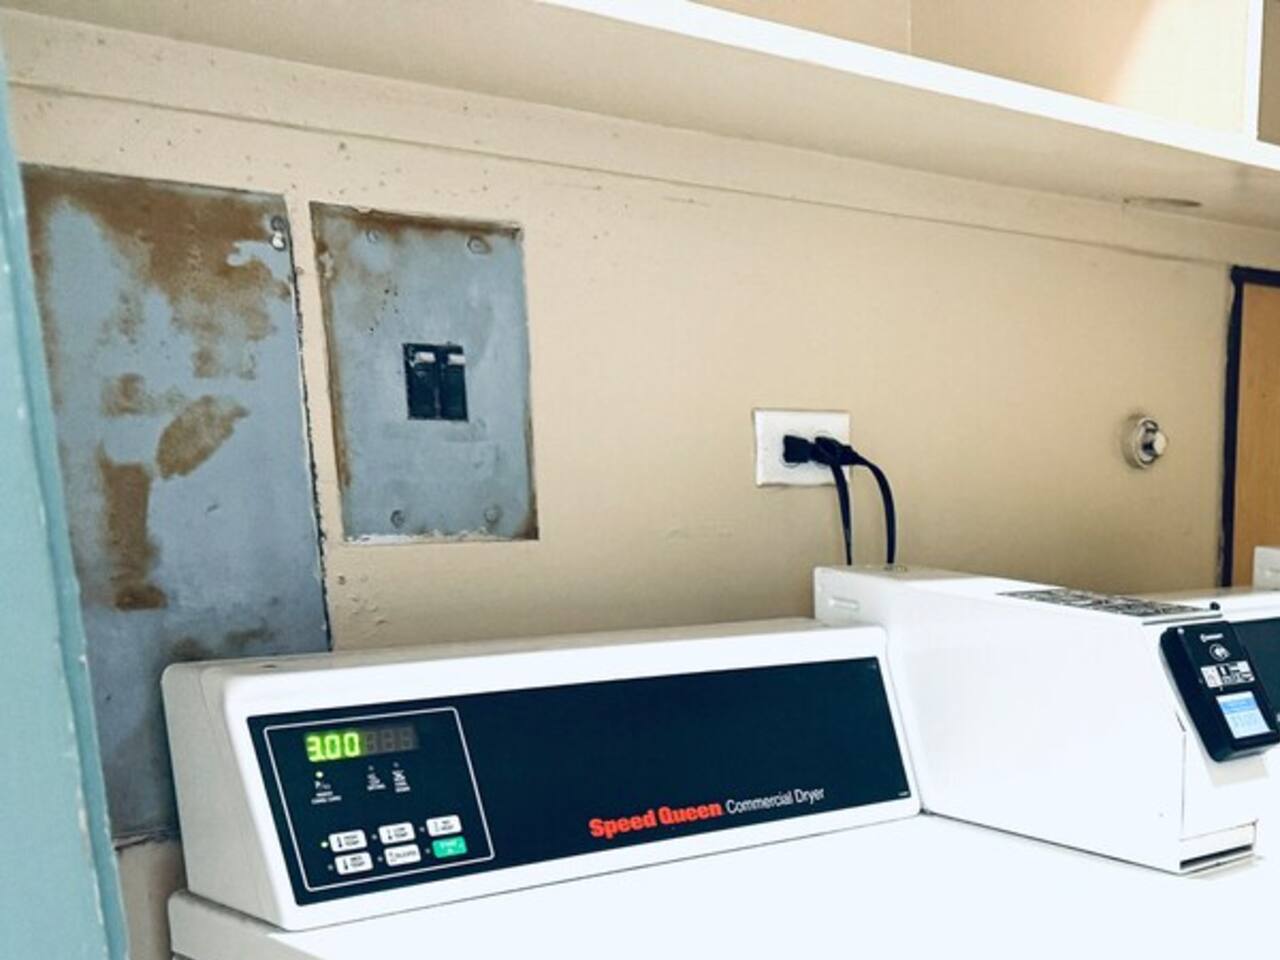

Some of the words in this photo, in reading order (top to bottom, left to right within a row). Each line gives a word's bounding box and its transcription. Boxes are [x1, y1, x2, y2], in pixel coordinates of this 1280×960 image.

[588, 809, 657, 839] Speed
[658, 801, 723, 826] Queen
[725, 791, 793, 815] Commercial
[795, 787, 825, 805] Dryer
